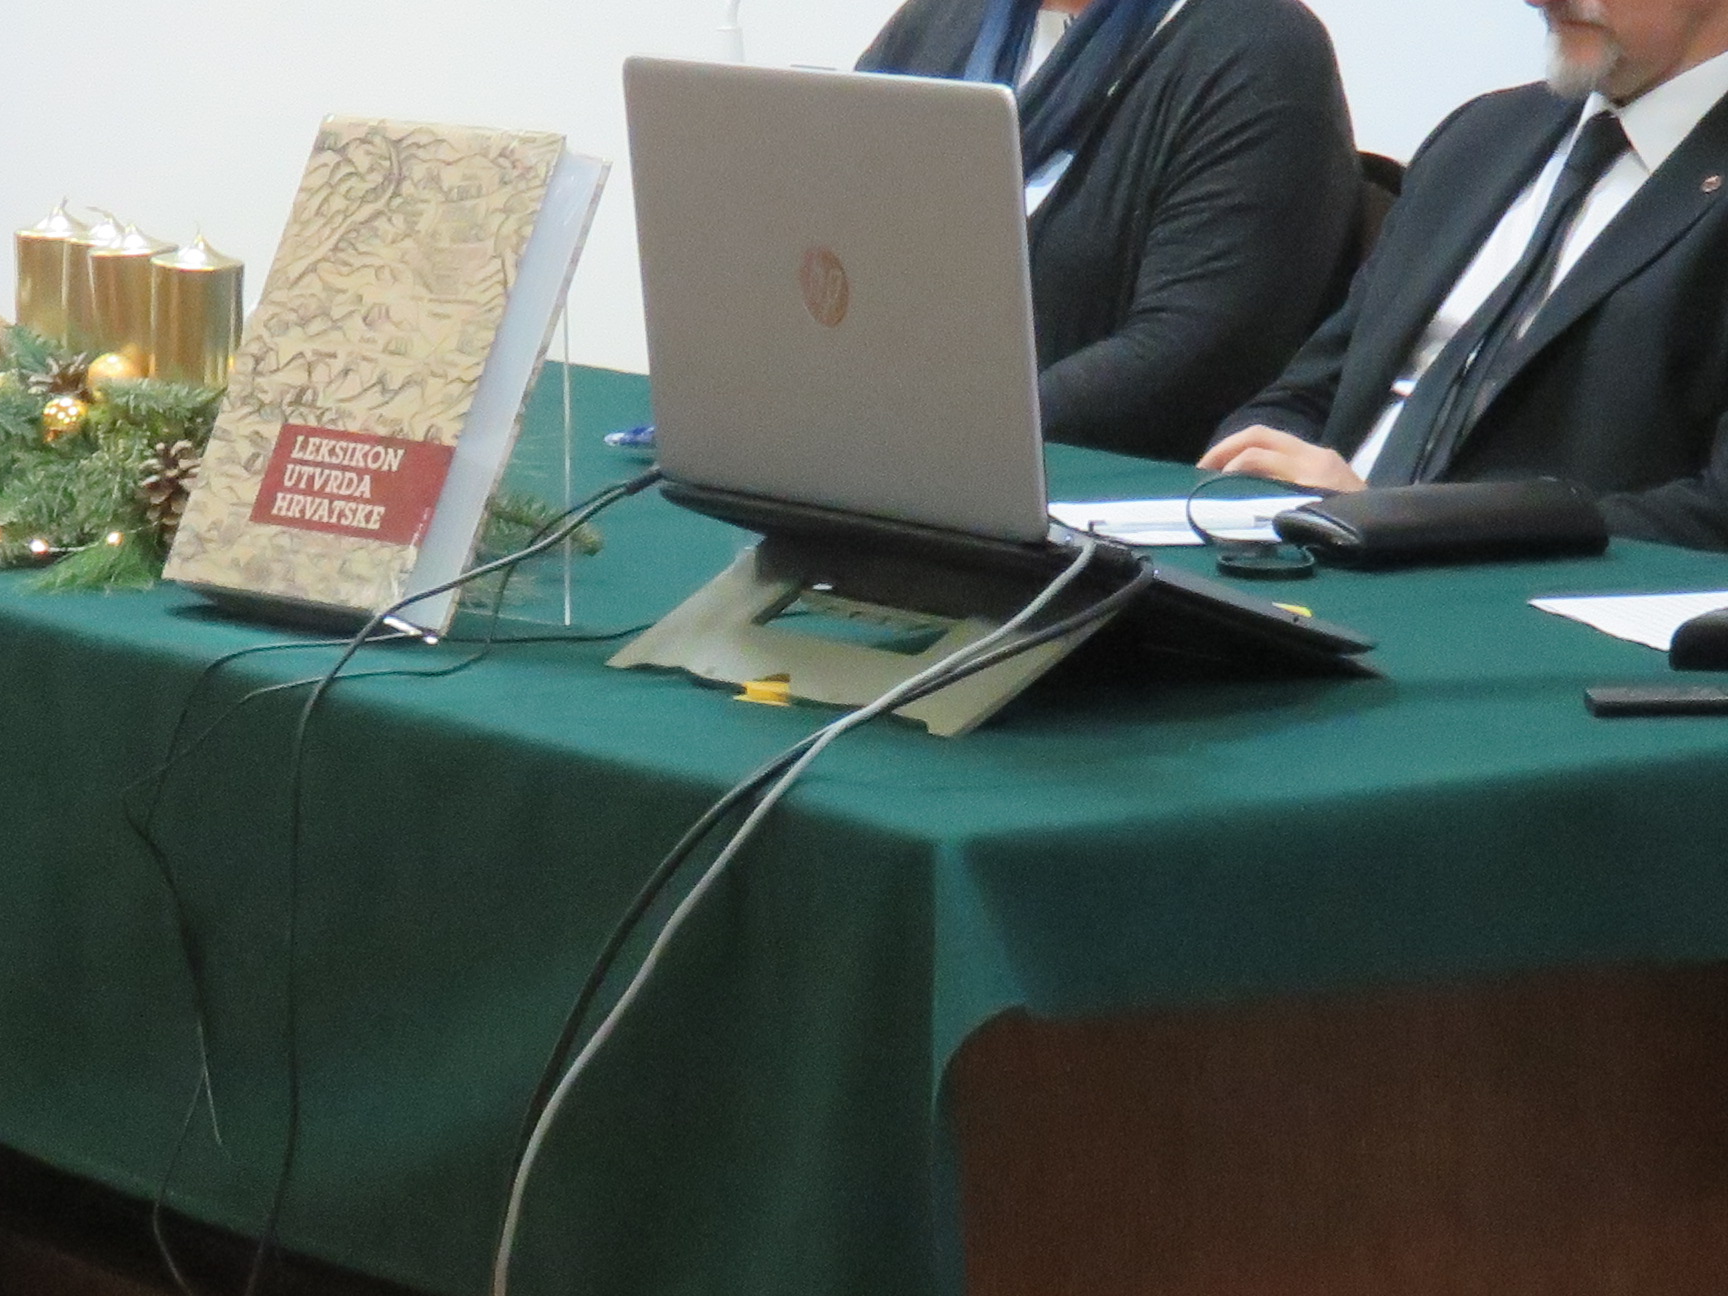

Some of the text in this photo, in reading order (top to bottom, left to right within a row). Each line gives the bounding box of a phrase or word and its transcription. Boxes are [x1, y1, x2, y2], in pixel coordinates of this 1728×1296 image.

[291, 436, 404, 471] LEKSIKON
[283, 464, 373, 499] UTVRDA
[271, 492, 386, 530] HRVATSKE
